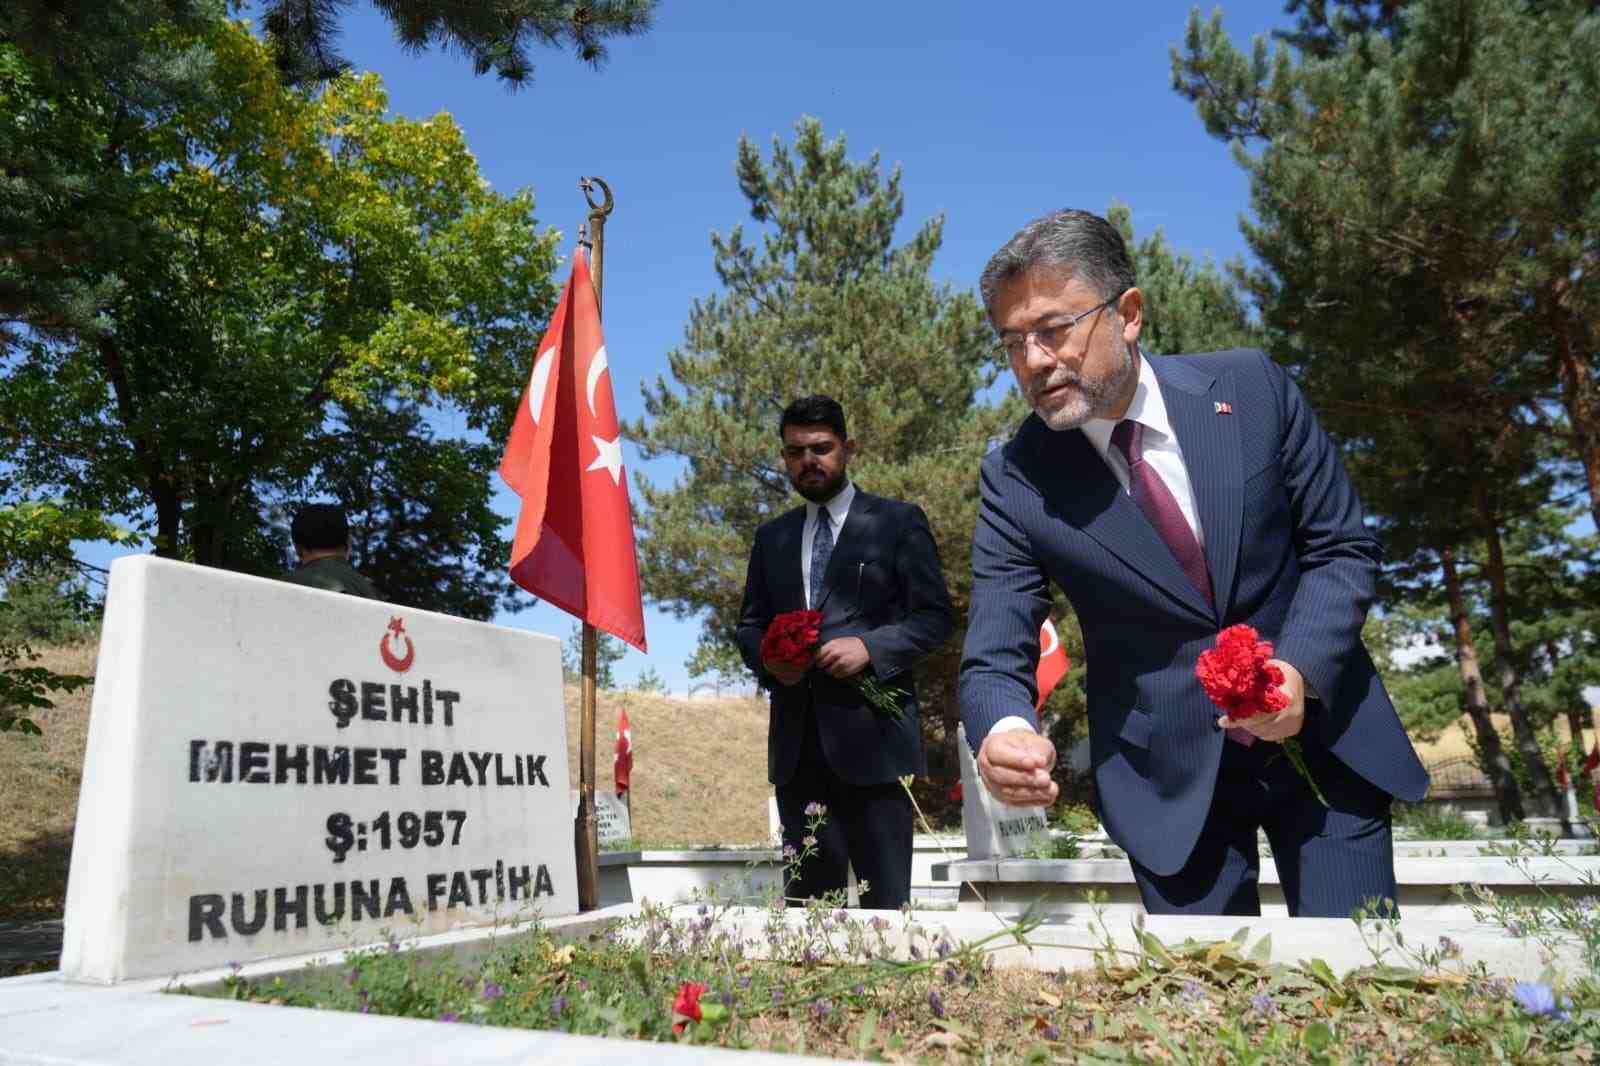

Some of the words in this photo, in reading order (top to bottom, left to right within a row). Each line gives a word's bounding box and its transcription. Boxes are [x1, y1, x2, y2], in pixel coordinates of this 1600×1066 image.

[329, 678, 460, 728] ŞEHİT
[189, 739, 408, 785] MEHMET
[421, 750, 550, 786] BAYLIK
[325, 811, 467, 862] Ş:1957
[188, 876, 414, 942] RUHUNA
[427, 859, 555, 911] FATİHA
